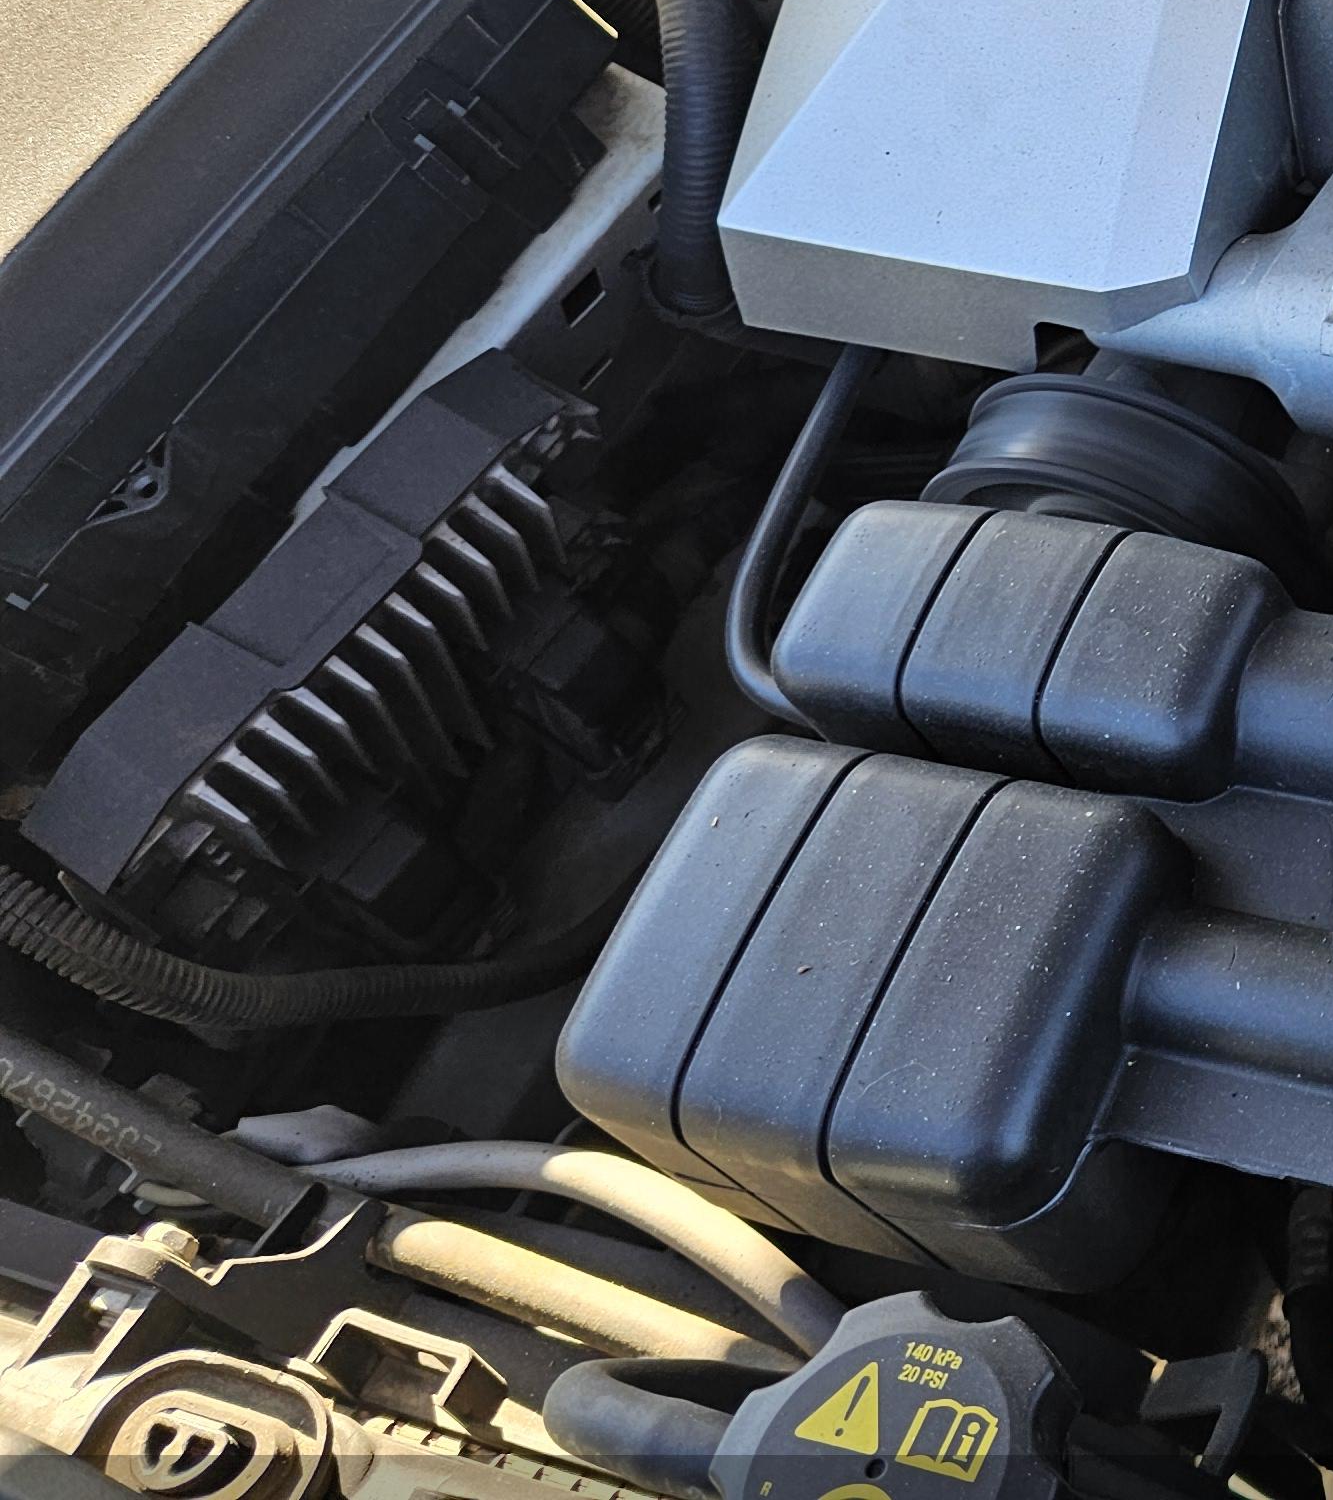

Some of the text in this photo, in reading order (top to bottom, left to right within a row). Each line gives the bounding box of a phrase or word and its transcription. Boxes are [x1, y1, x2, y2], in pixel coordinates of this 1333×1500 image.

[905, 1341, 963, 1370] 140 kPa
[897, 1363, 949, 1390] 20 PSI
